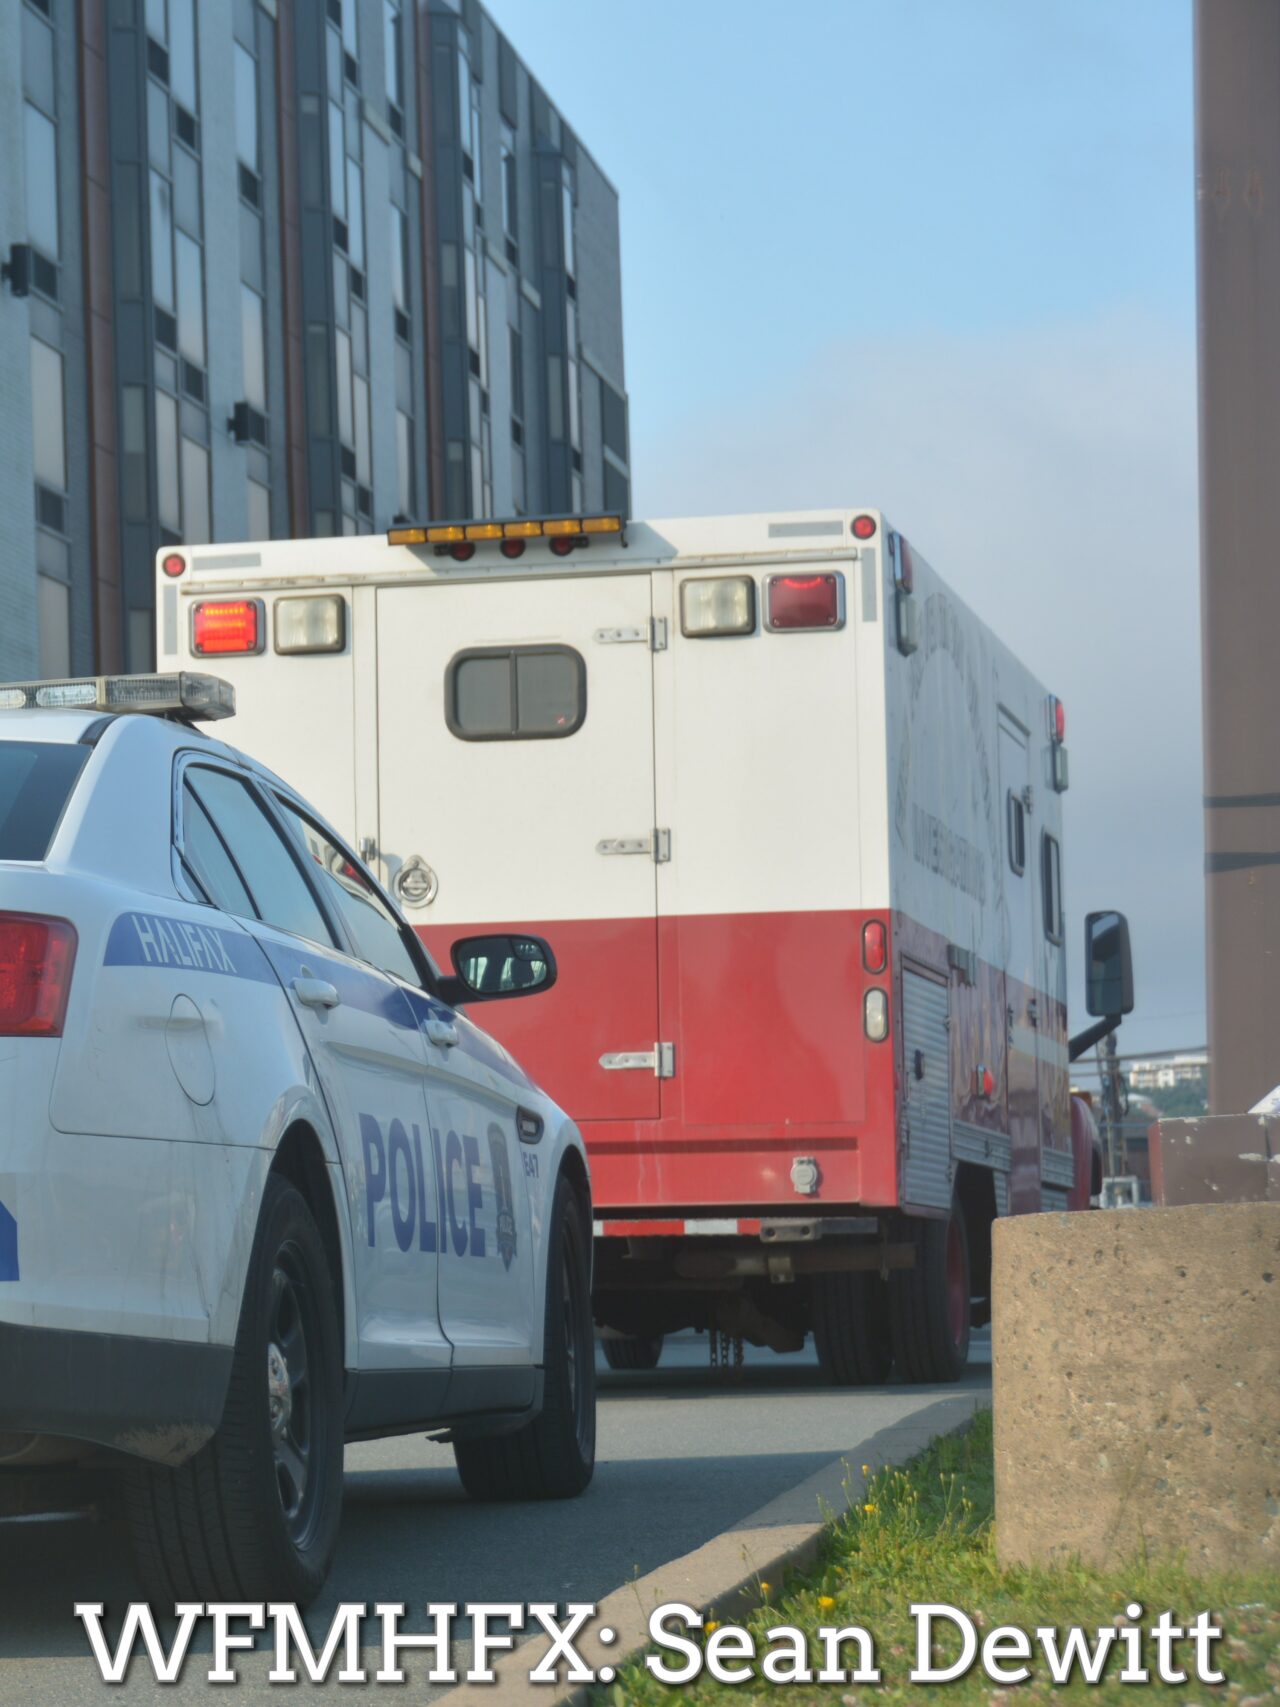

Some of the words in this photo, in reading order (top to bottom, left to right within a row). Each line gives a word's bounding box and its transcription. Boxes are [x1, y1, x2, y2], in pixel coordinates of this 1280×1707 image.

[131, 914, 238, 974] HALIFAX
[358, 1112, 486, 1258] POLICE
[523, 1151, 539, 1178] E47
